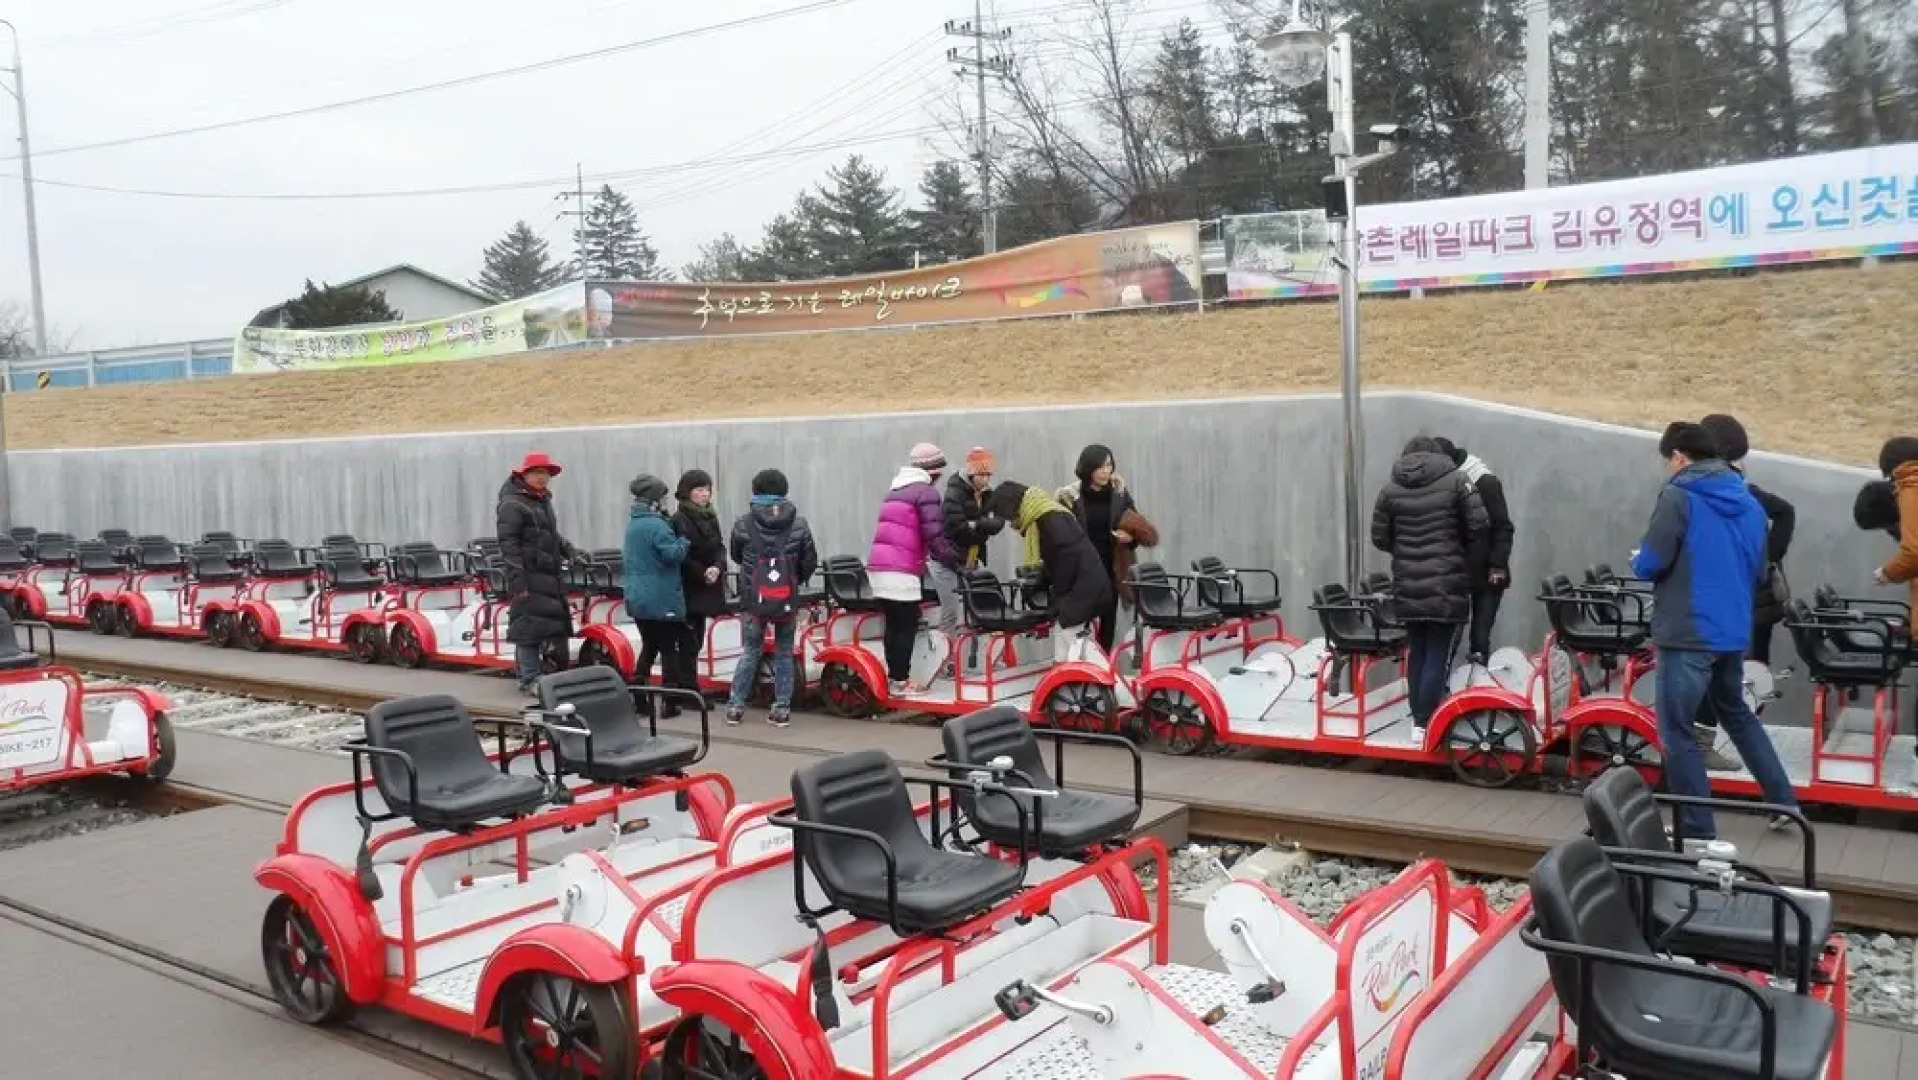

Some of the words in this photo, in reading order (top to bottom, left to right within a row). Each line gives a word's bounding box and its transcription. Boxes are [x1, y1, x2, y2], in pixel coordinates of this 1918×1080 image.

[1551, 192, 1746, 250] 김유정역에
[692, 287, 775, 329] 추억으로
[837, 277, 961, 320] 레일바이크
